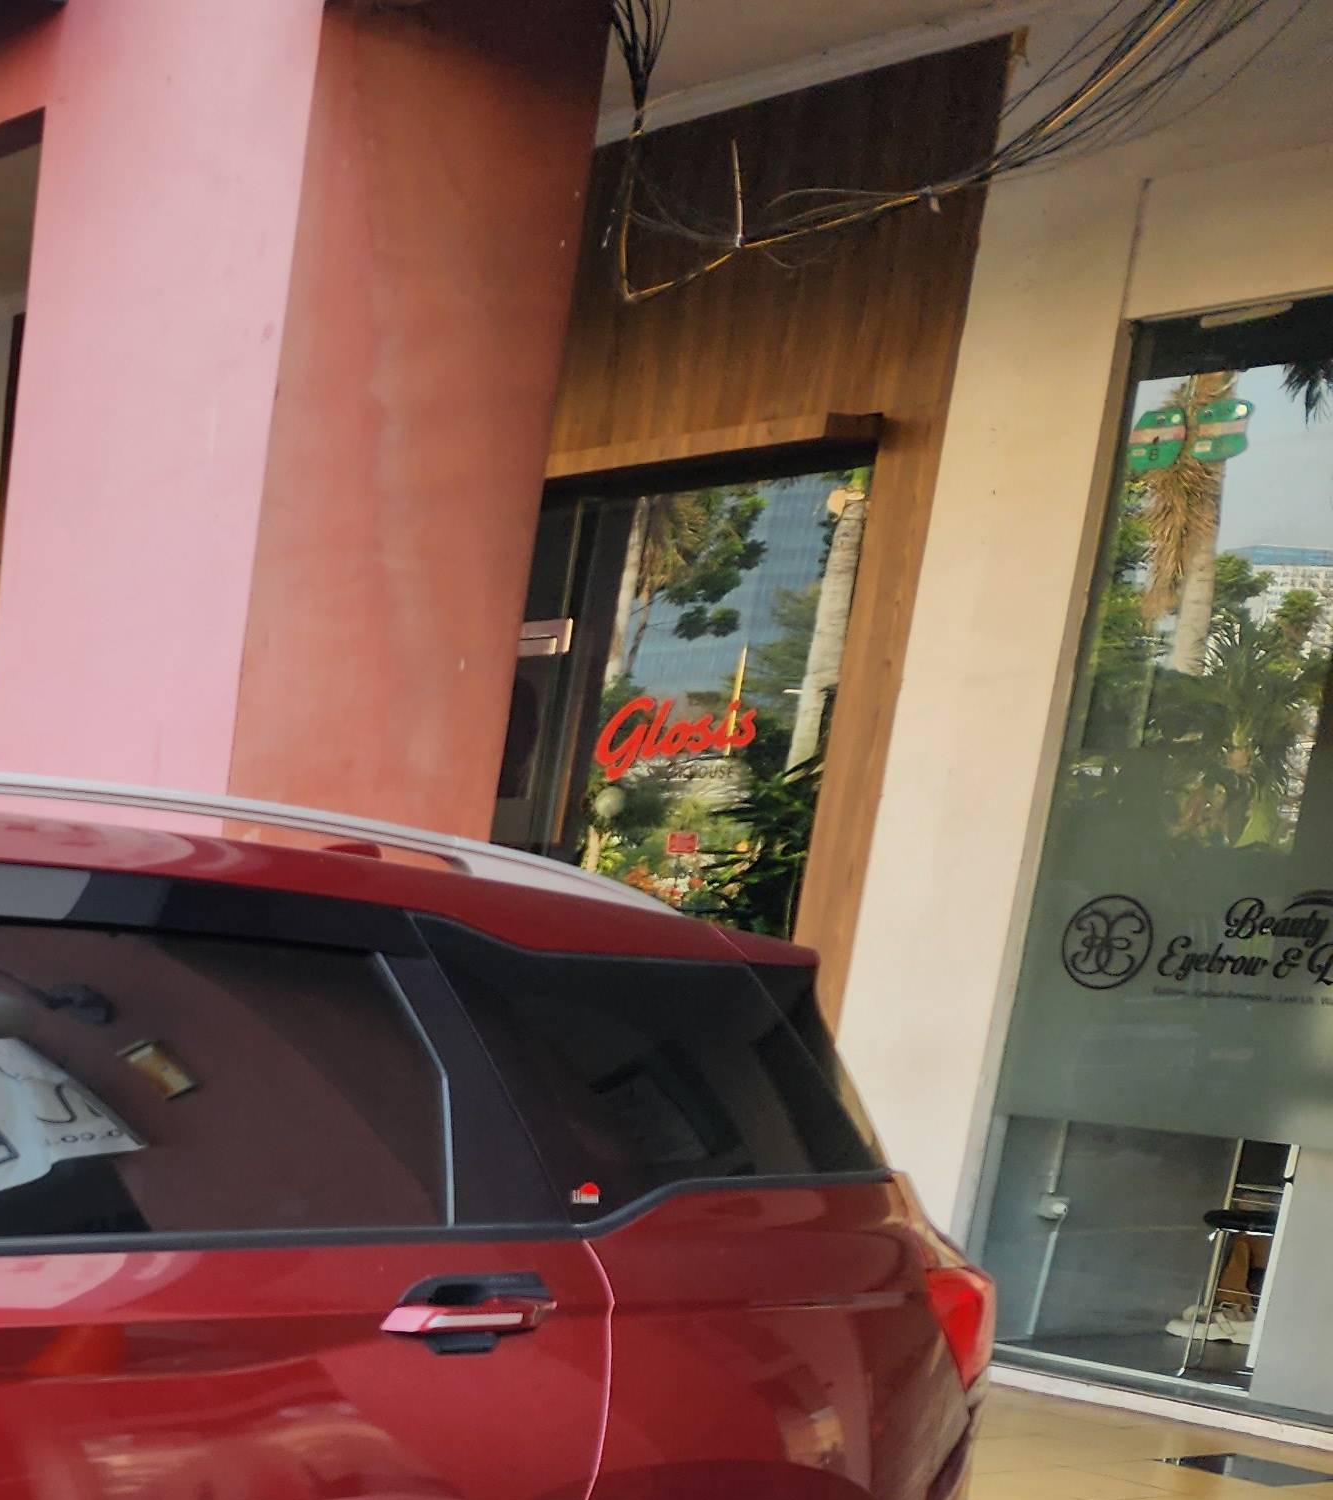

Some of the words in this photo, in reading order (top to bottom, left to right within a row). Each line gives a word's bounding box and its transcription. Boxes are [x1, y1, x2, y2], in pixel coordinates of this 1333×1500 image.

[596, 695, 758, 783] Glosis
[1224, 897, 1330, 947] Beauty
[1156, 935, 1271, 981] Eyebrow
